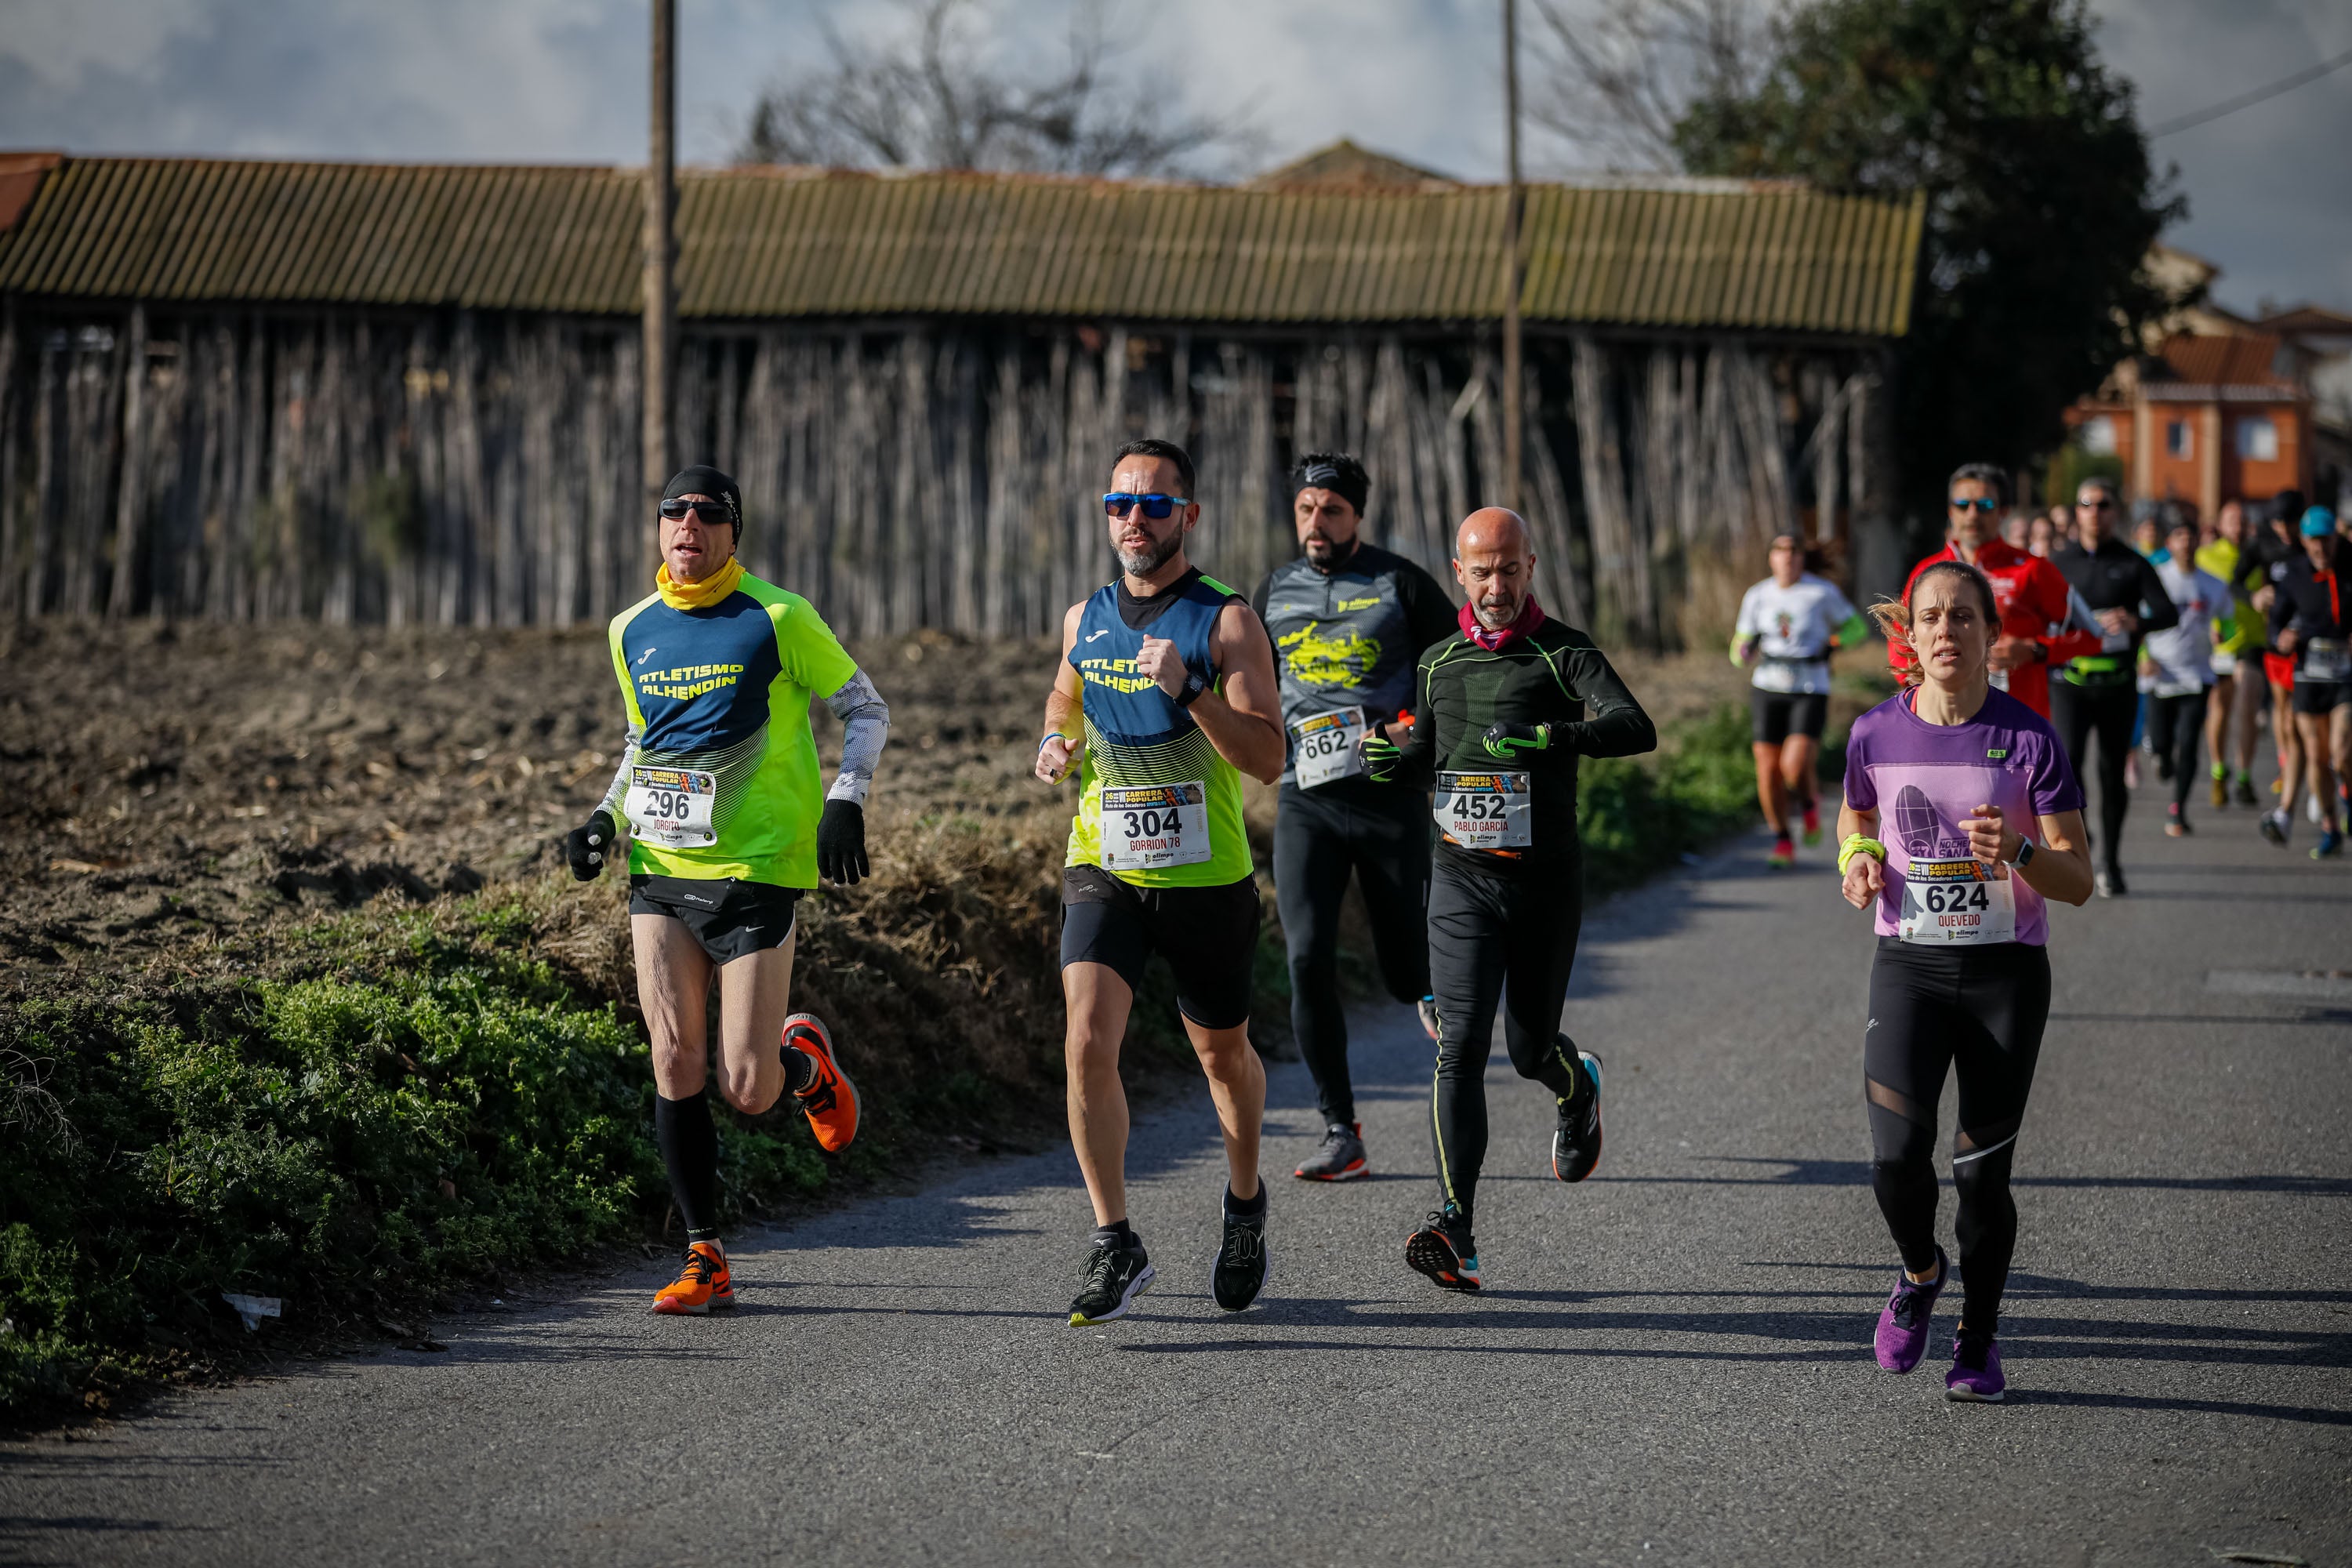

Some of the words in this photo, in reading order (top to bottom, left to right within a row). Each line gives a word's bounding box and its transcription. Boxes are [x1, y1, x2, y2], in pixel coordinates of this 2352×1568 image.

[639, 664, 744, 684] ATLETISMO
[642, 675, 737, 701] ALHENDÍN
[1305, 731, 1349, 760] 662
[652, 771, 680, 779] CARRERA
[644, 790, 690, 820] 296
[1453, 795, 1506, 820] 452
[1123, 808, 1182, 839] 304
[1454, 821, 1477, 832] PABLO
[1479, 819, 1508, 832] GARCÍA
[1130, 838, 1167, 851] GORRION
[1169, 837, 1181, 848] 78
[1926, 883, 1990, 913] 624
[1938, 914, 1980, 927] QUEVEDO
